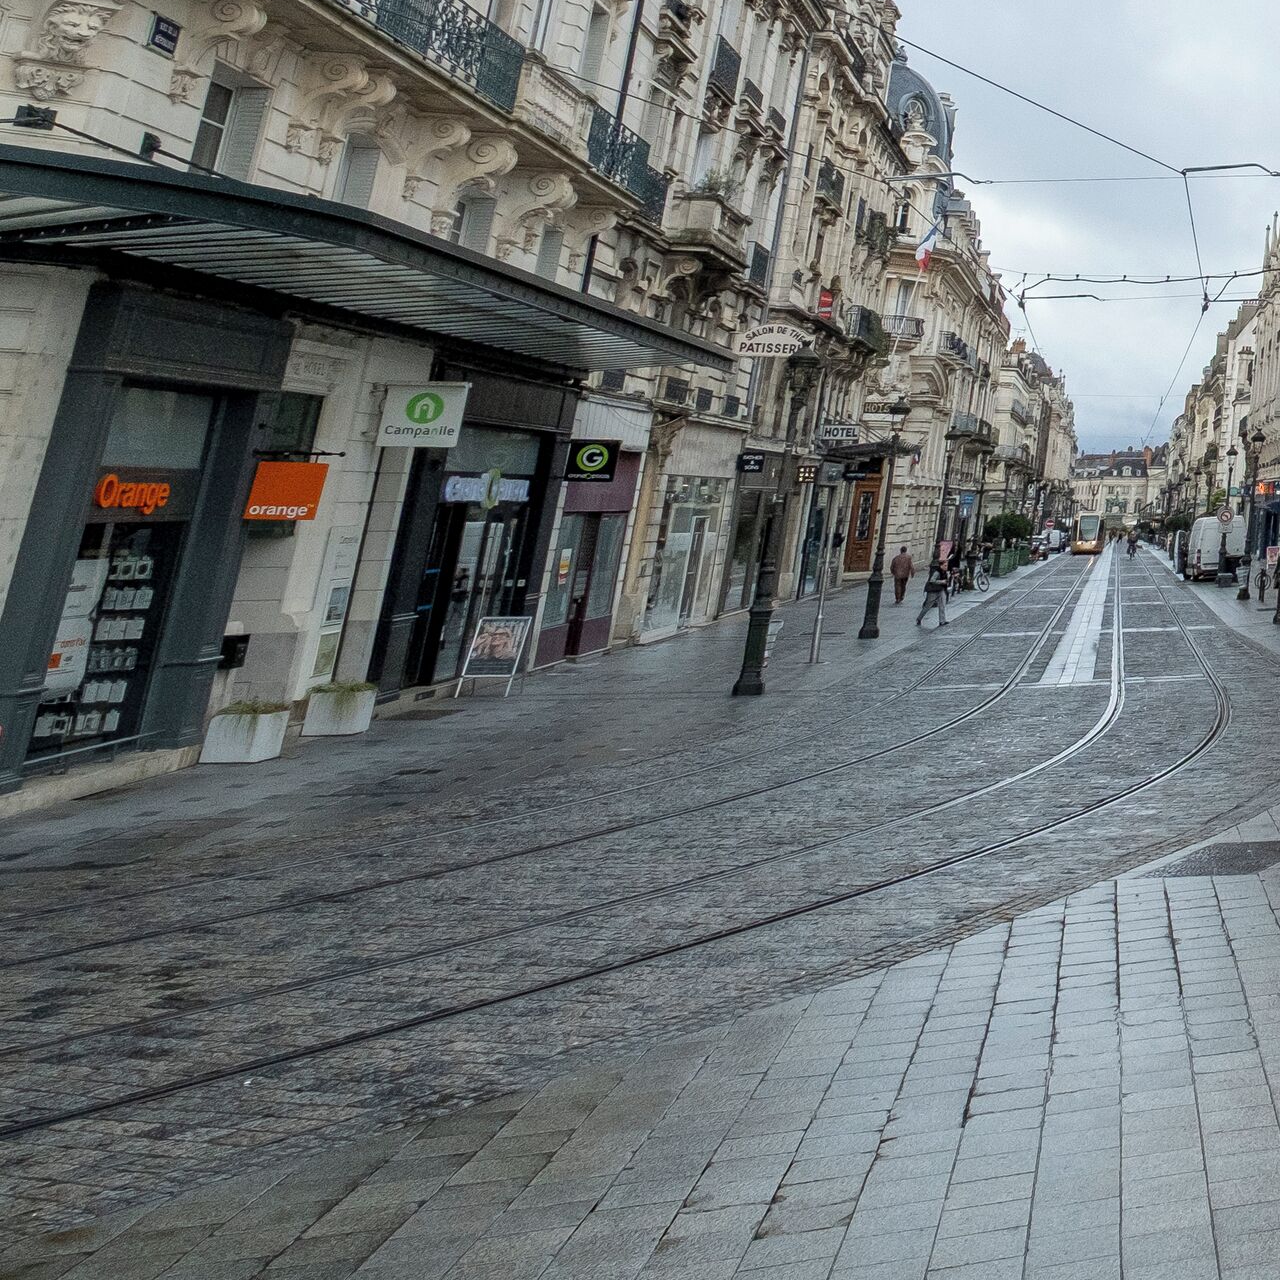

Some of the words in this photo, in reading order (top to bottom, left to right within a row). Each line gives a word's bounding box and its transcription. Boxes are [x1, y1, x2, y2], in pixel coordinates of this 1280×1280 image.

[746, 326, 774, 341] SALON
[777, 326, 788, 335] DE
[739, 342, 802, 354] PATISSERI
[385, 425, 455, 439] Campanile
[824, 427, 859, 438] HOTEL
[97, 474, 171, 514] Orange
[249, 504, 308, 519] orange
